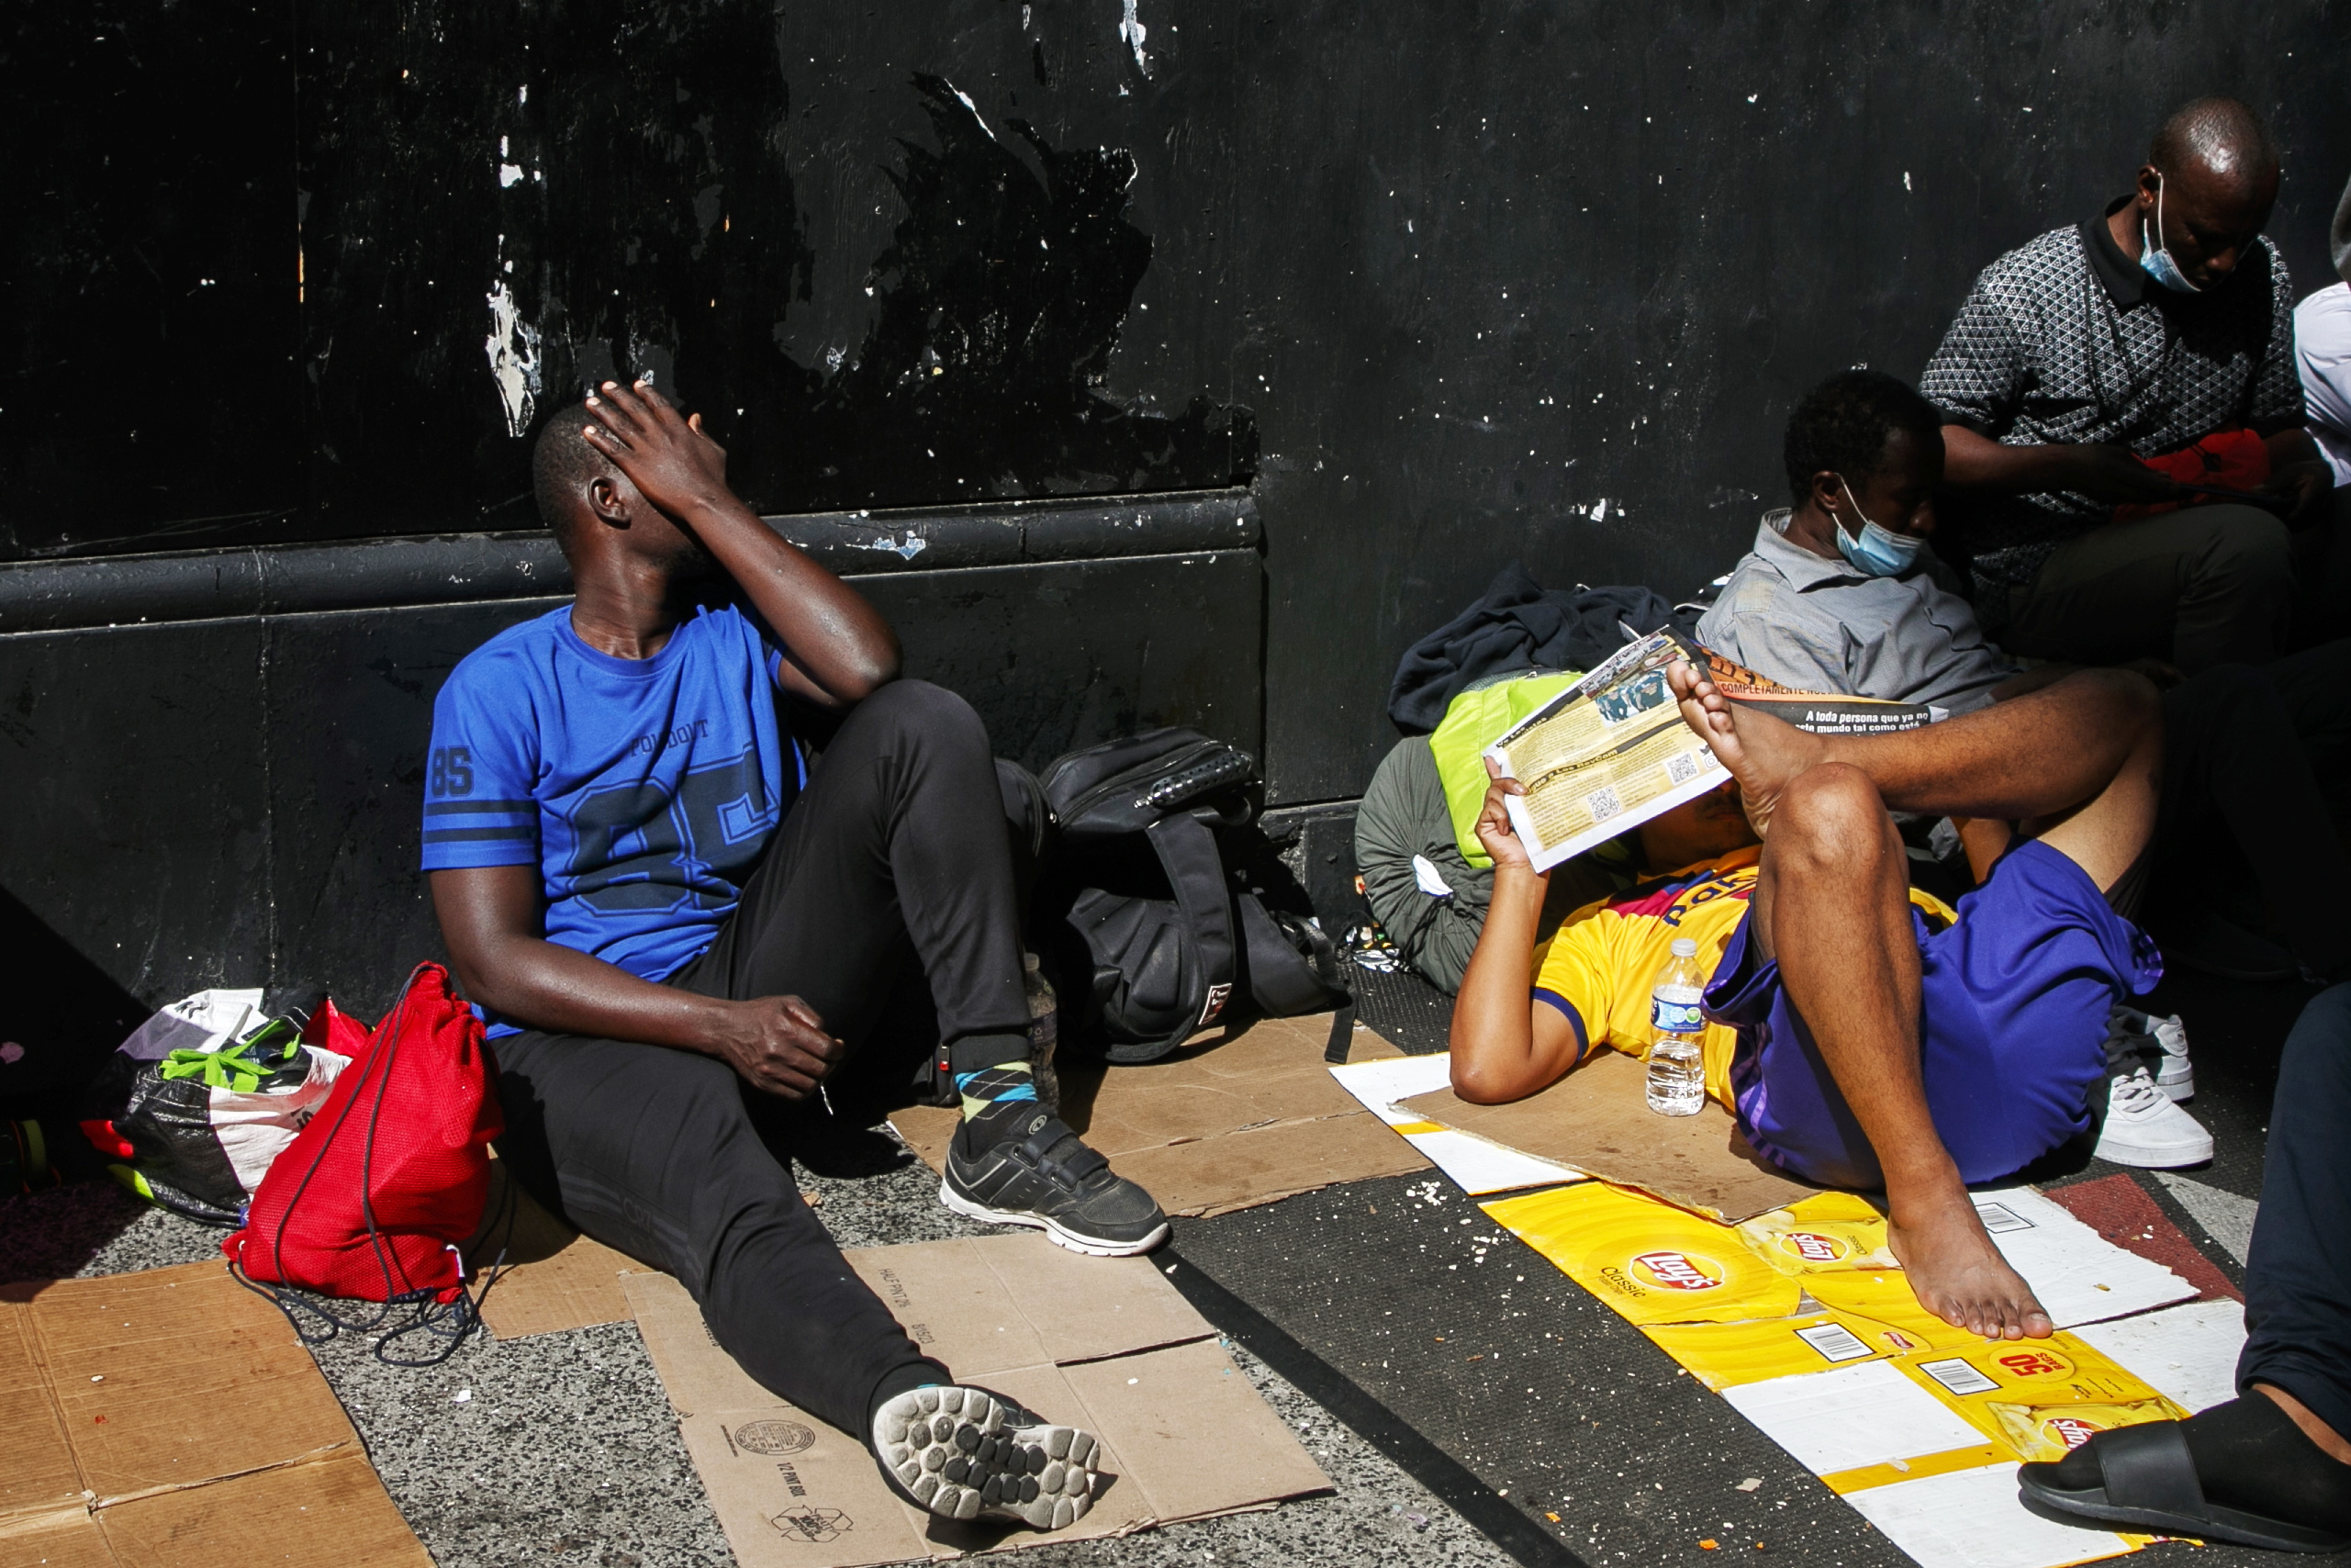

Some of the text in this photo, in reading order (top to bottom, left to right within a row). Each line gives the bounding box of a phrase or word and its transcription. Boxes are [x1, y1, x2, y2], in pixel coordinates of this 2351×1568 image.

[1805, 711, 1814, 722] A
[1815, 711, 1838, 722] toda
[1839, 713, 1878, 725] persona
[1880, 714, 1899, 724] que
[1901, 713, 1914, 723] ya
[1817, 723, 1852, 734] mundo
[1853, 723, 1867, 732] tal
[1868, 723, 1897, 732] como
[431, 745, 475, 799] 85
[1790, 1234, 1836, 1260] Lay's
[1601, 1267, 1646, 1297] Classic
[1640, 1254, 1714, 1289] Lay's
[1998, 1354, 2054, 1377] 50
[2035, 1352, 2066, 1371] BAGS
